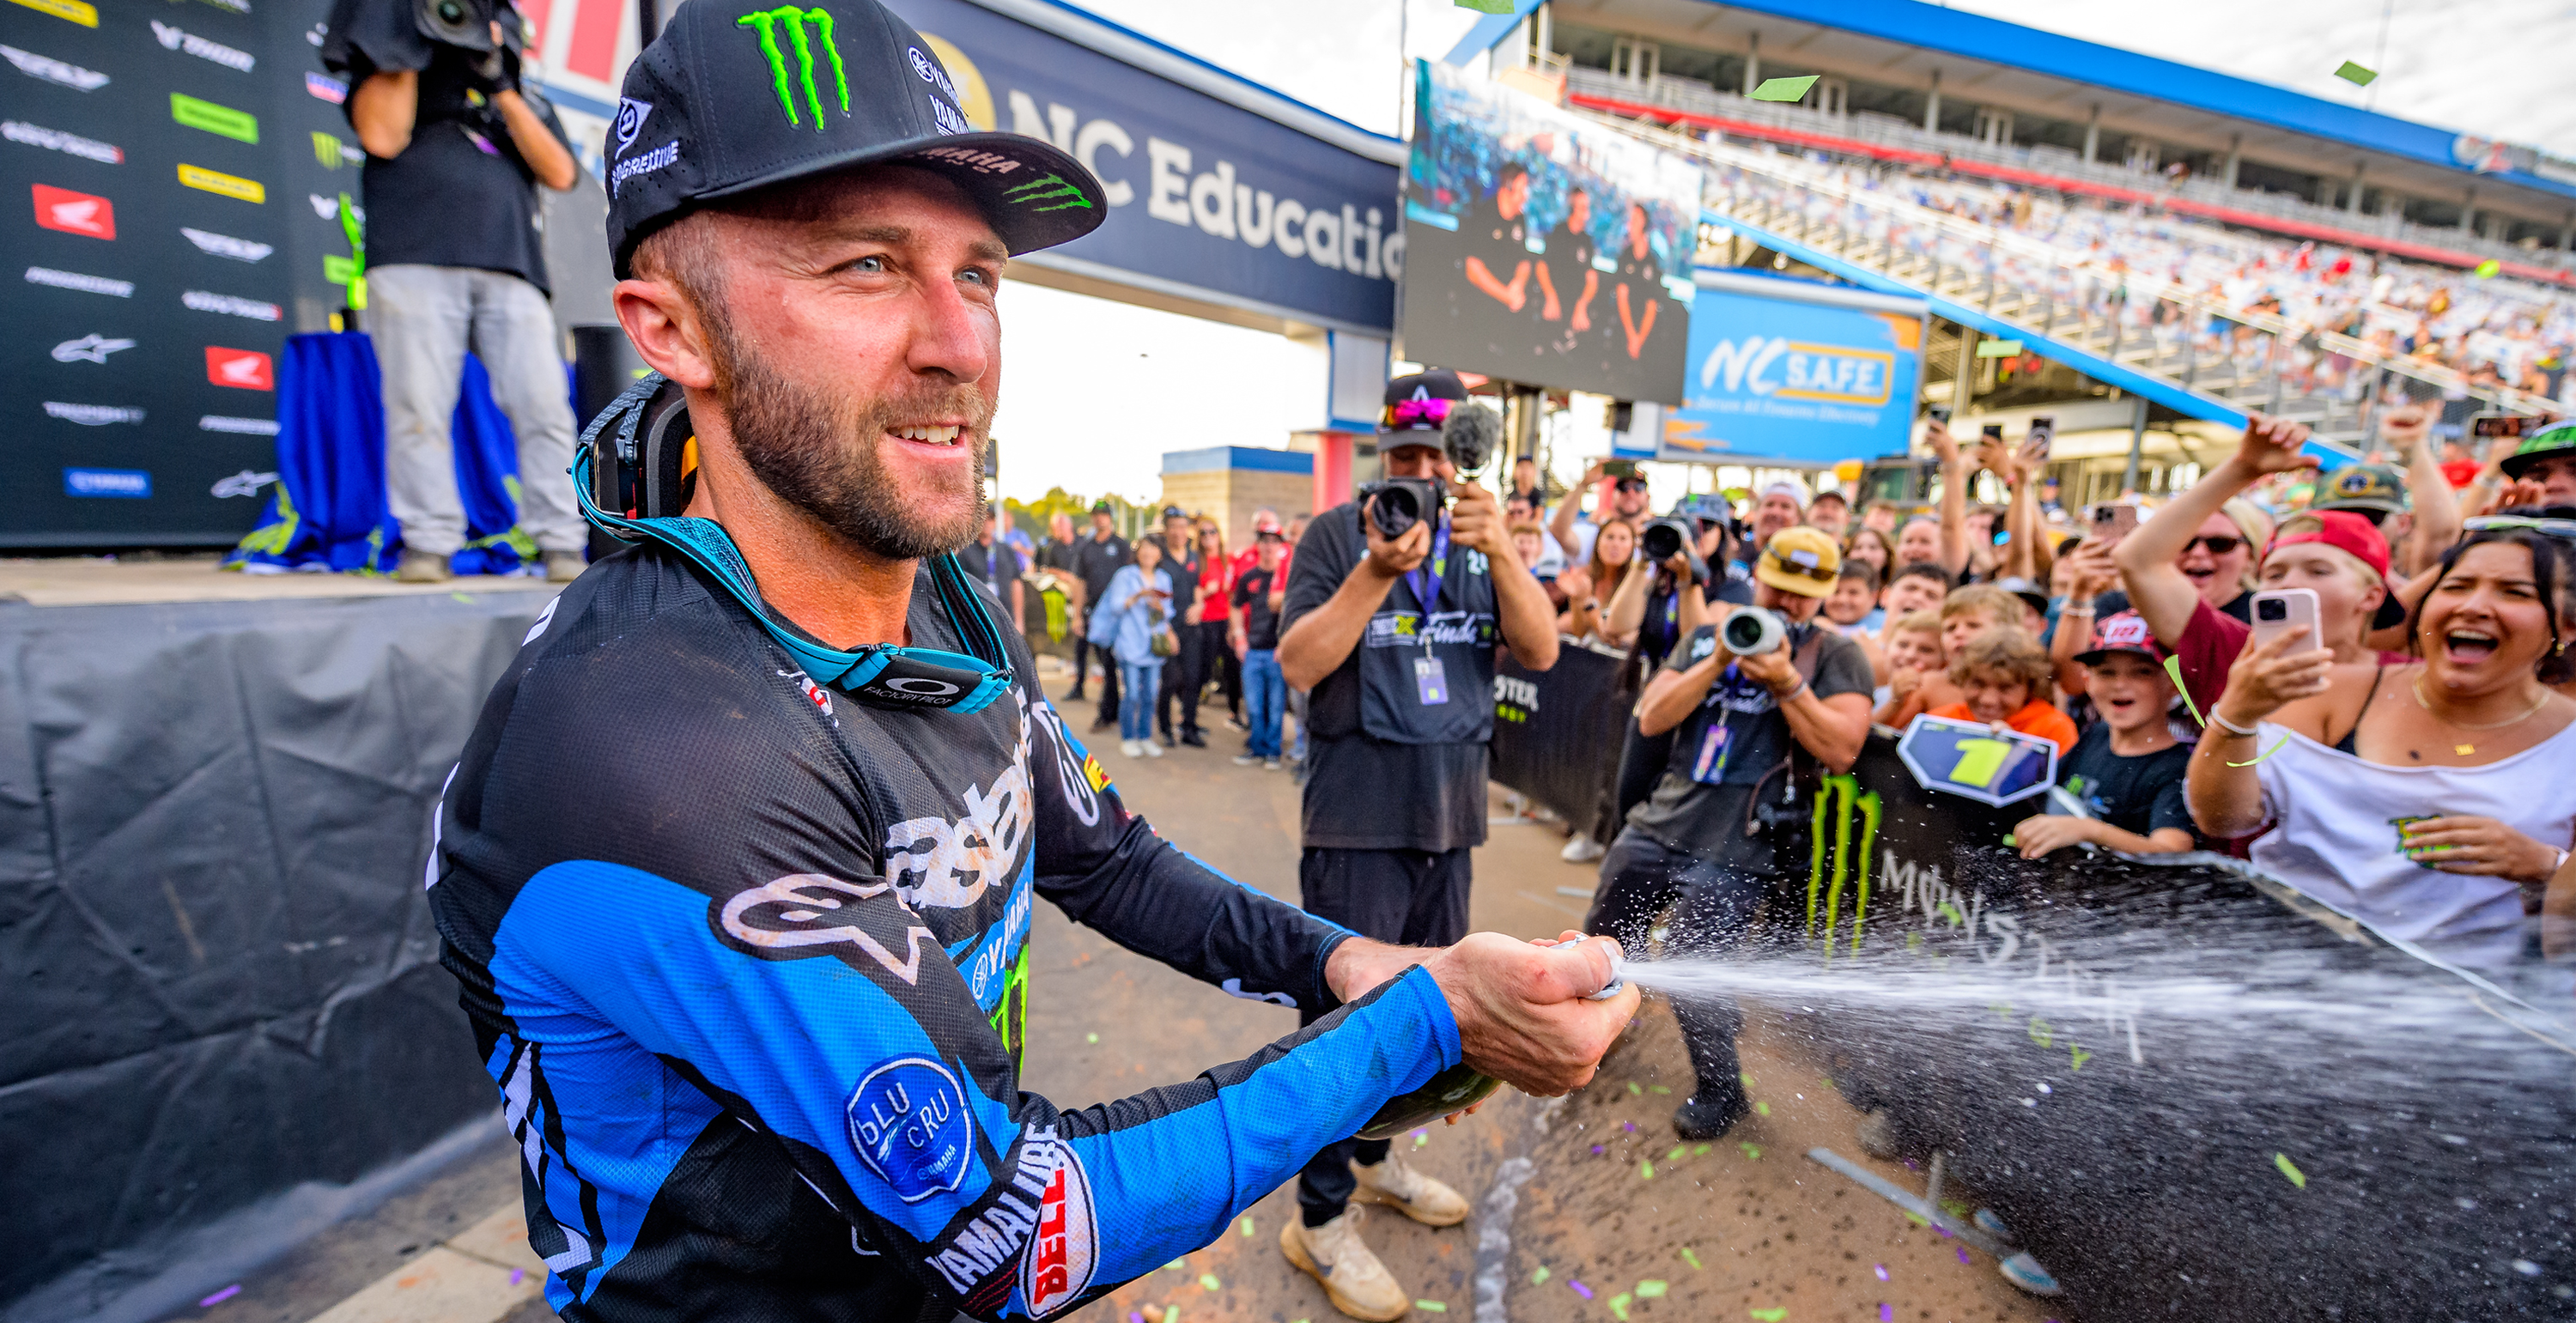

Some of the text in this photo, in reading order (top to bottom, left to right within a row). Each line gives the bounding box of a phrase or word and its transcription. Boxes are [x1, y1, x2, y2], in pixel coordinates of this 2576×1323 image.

[1146, 137, 1406, 282] Educatio
[1699, 334, 1789, 396] NC
[863, 686, 953, 705] FACTORY PILOT
[1948, 737, 2013, 788] 1
[1033, 1168, 1068, 1304] BELL
